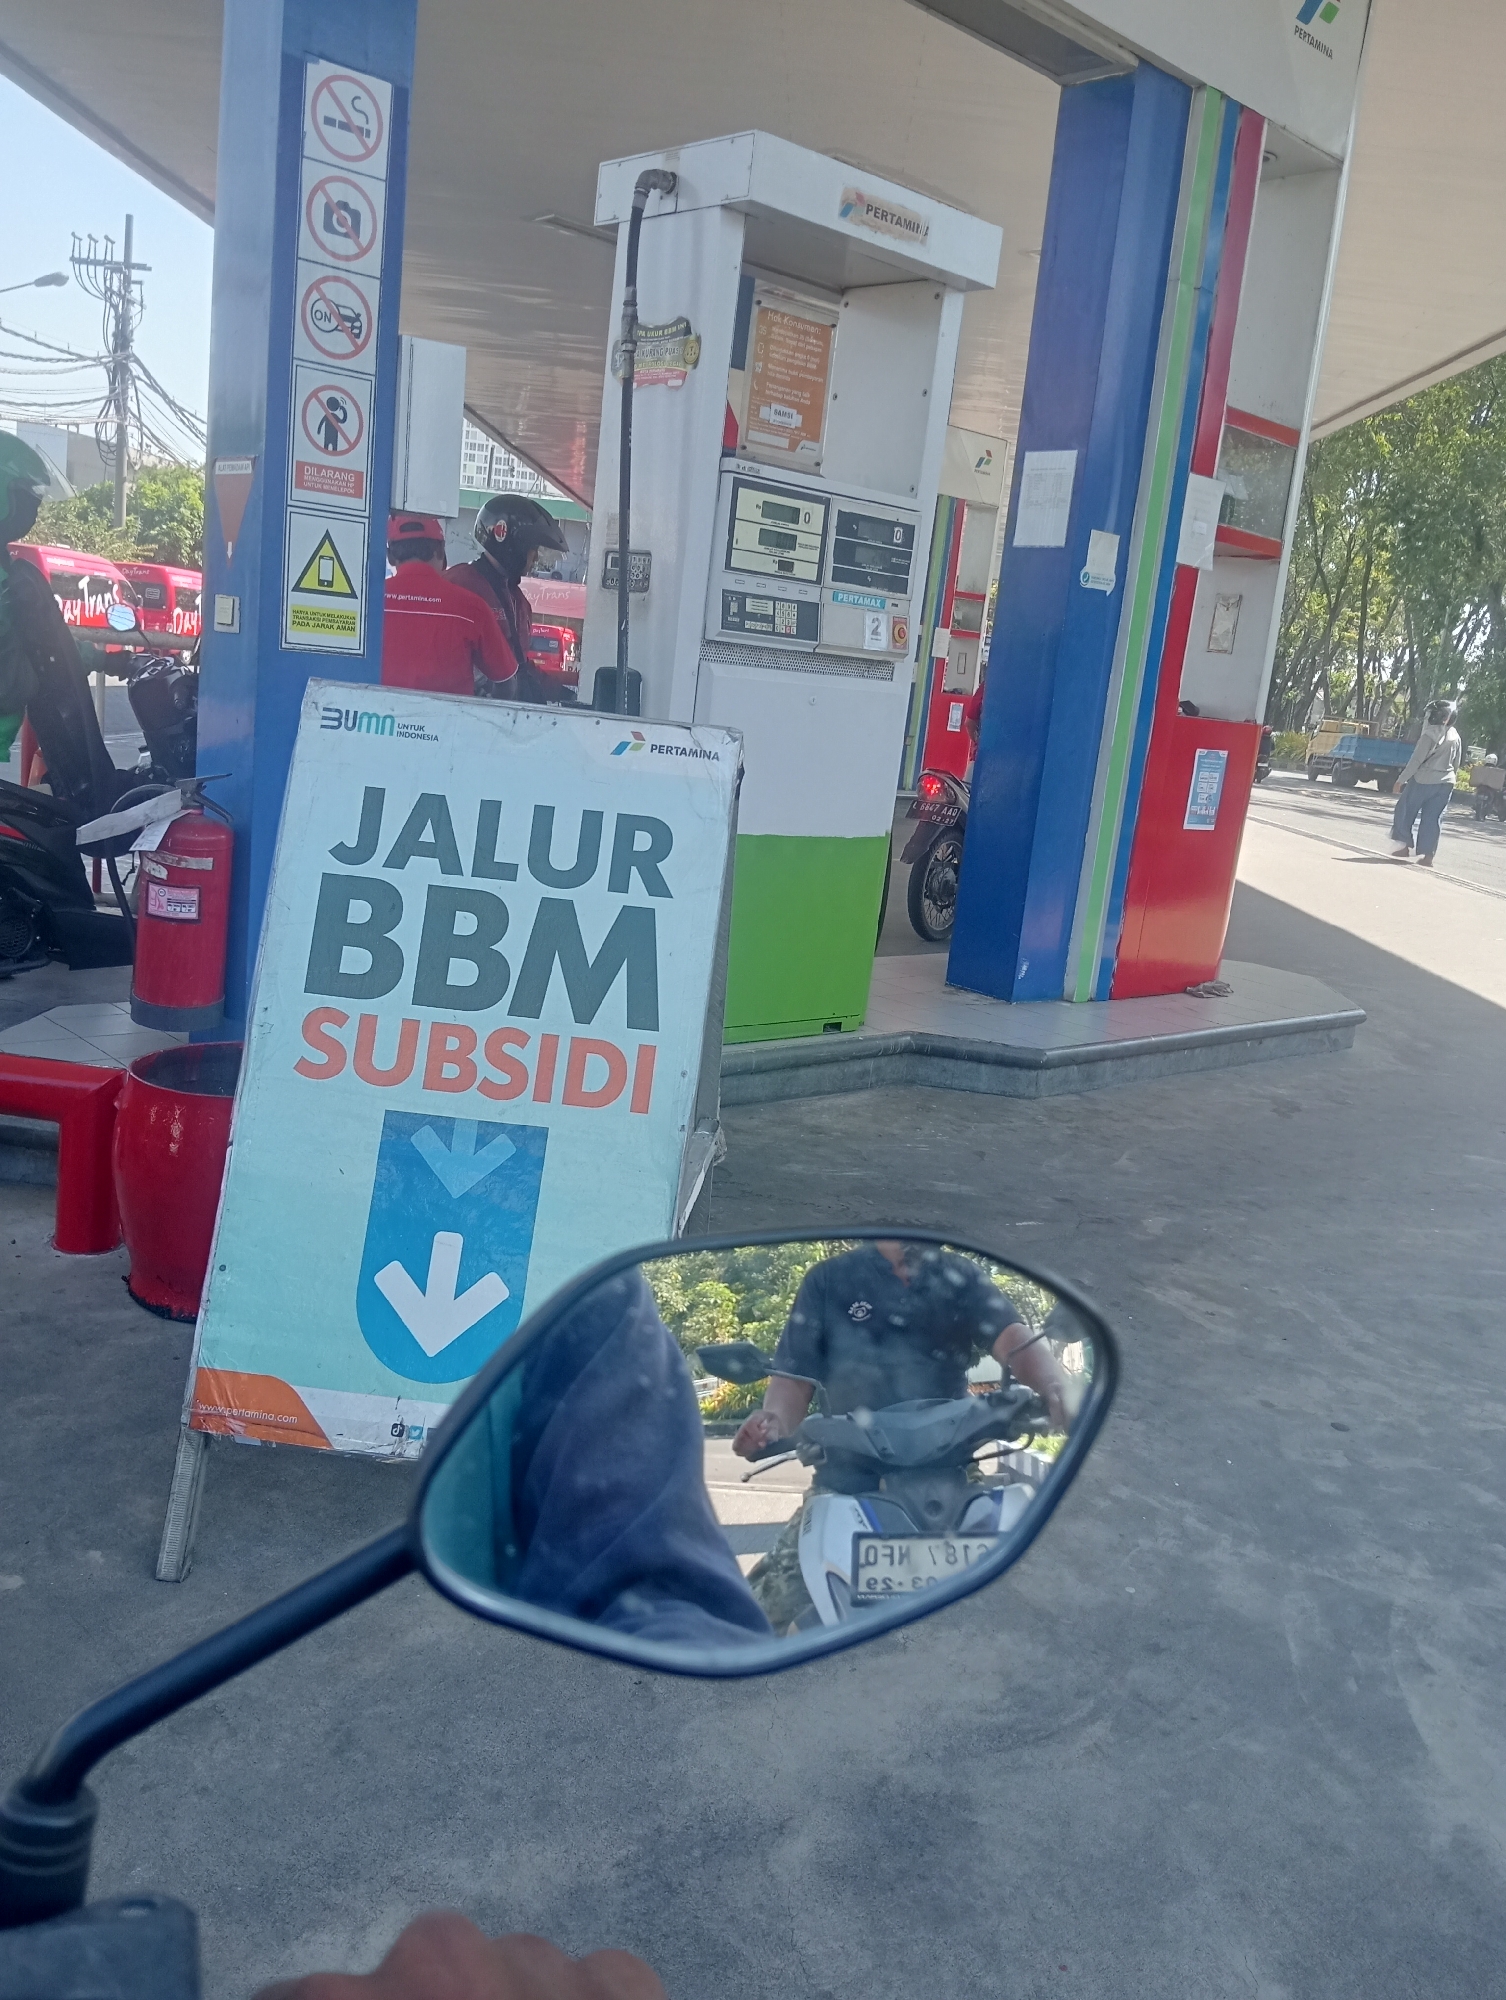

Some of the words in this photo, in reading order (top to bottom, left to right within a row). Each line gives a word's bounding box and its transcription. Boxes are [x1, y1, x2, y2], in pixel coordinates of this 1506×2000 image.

[1294, 25, 1333, 60] PERTAMINA
[314, 309, 332, 323] ON
[304, 465, 355, 482] DILARANG
[303, 481, 322, 489] UNTUK
[837, 593, 882, 608] PERTAMAX
[292, 620, 310, 628] PADA
[311, 622, 335, 630] JARAK
[870, 617, 882, 637] 2
[396, 730, 440, 742] INDONESIA
[397, 723, 426, 733] UNTUK
[650, 743, 720, 761] PERTAMINA
[328, 785, 674, 899] JALUR
[304, 872, 660, 1032] BBM
[293, 1006, 657, 1114] SUBSIDI
